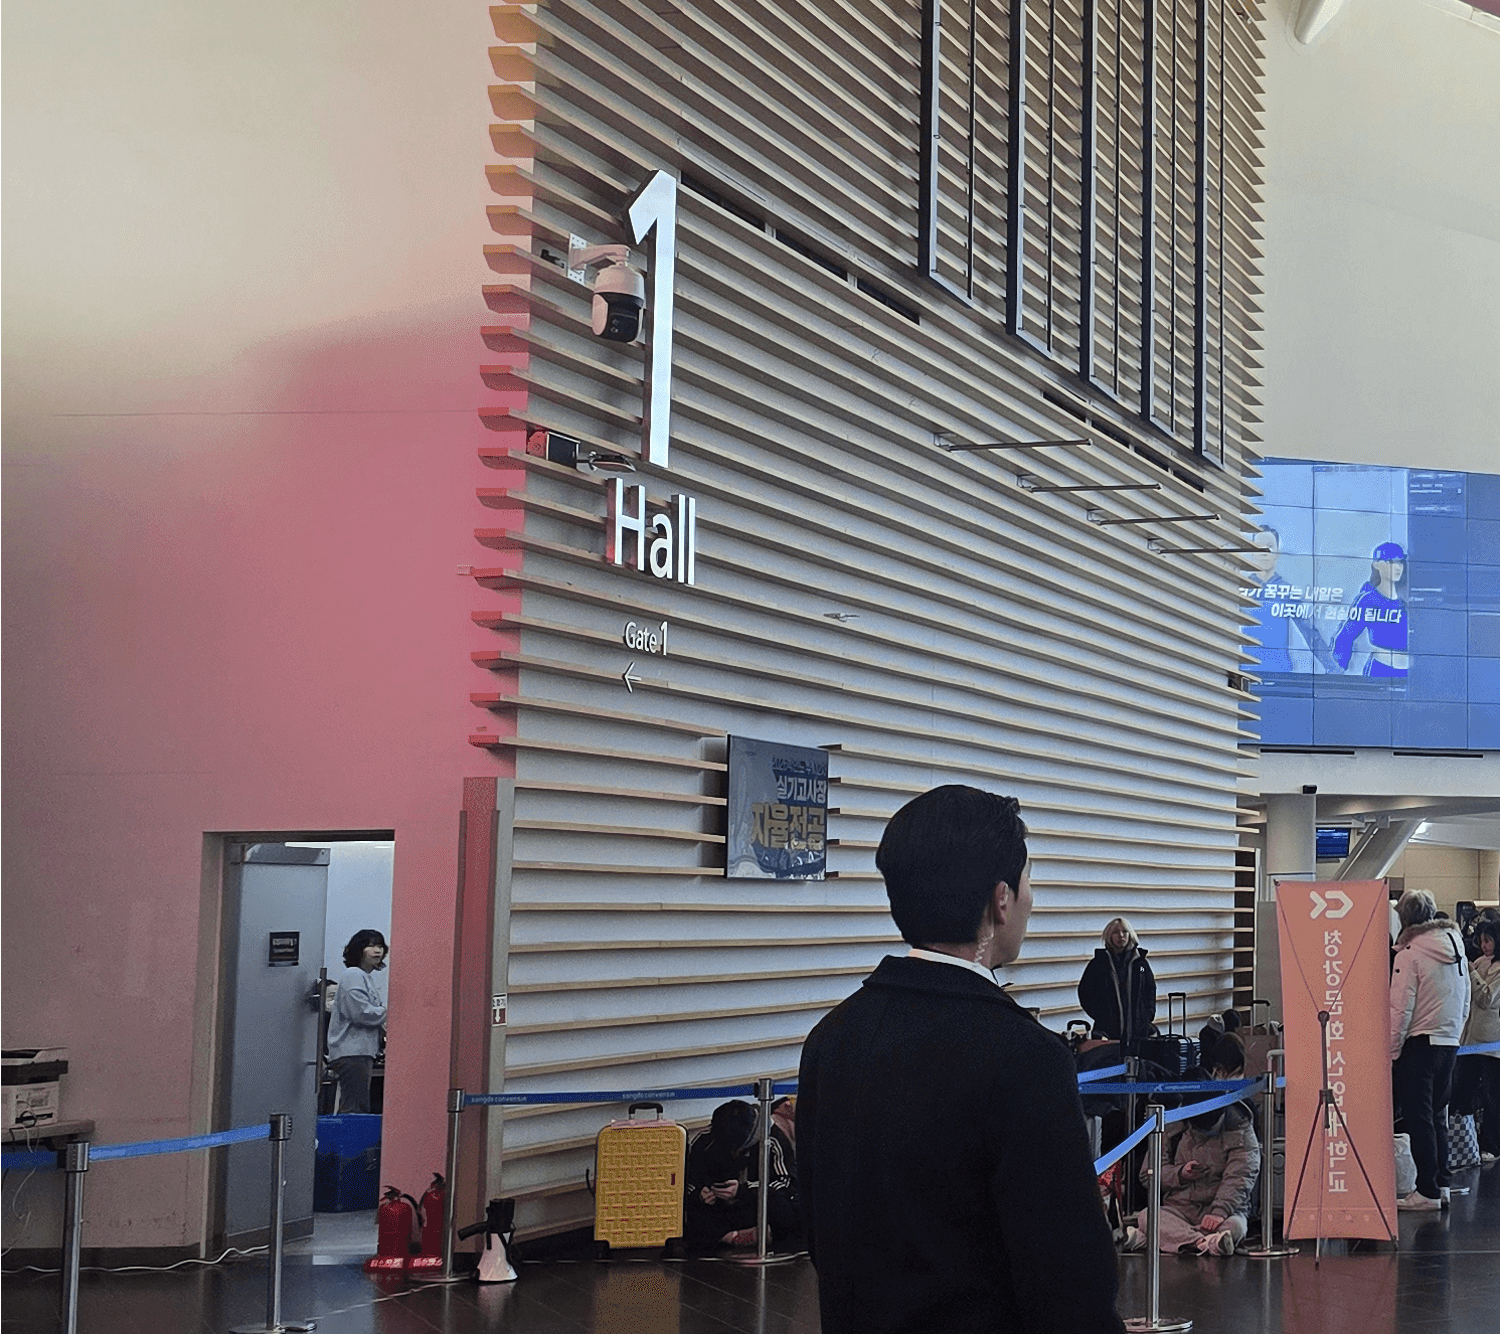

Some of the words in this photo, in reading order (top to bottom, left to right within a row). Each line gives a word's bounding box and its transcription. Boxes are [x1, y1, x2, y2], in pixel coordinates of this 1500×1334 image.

[627, 169, 677, 469] 1
[613, 477, 696, 586] Hall
[1264, 584, 1302, 600] 꿈꾸는
[1364, 608, 1402, 624] 됩니다
[625, 621, 657, 654] Gate
[660, 621, 668, 656] 1
[776, 775, 827, 804] 실기고사장
[751, 801, 825, 851] 자율전공
